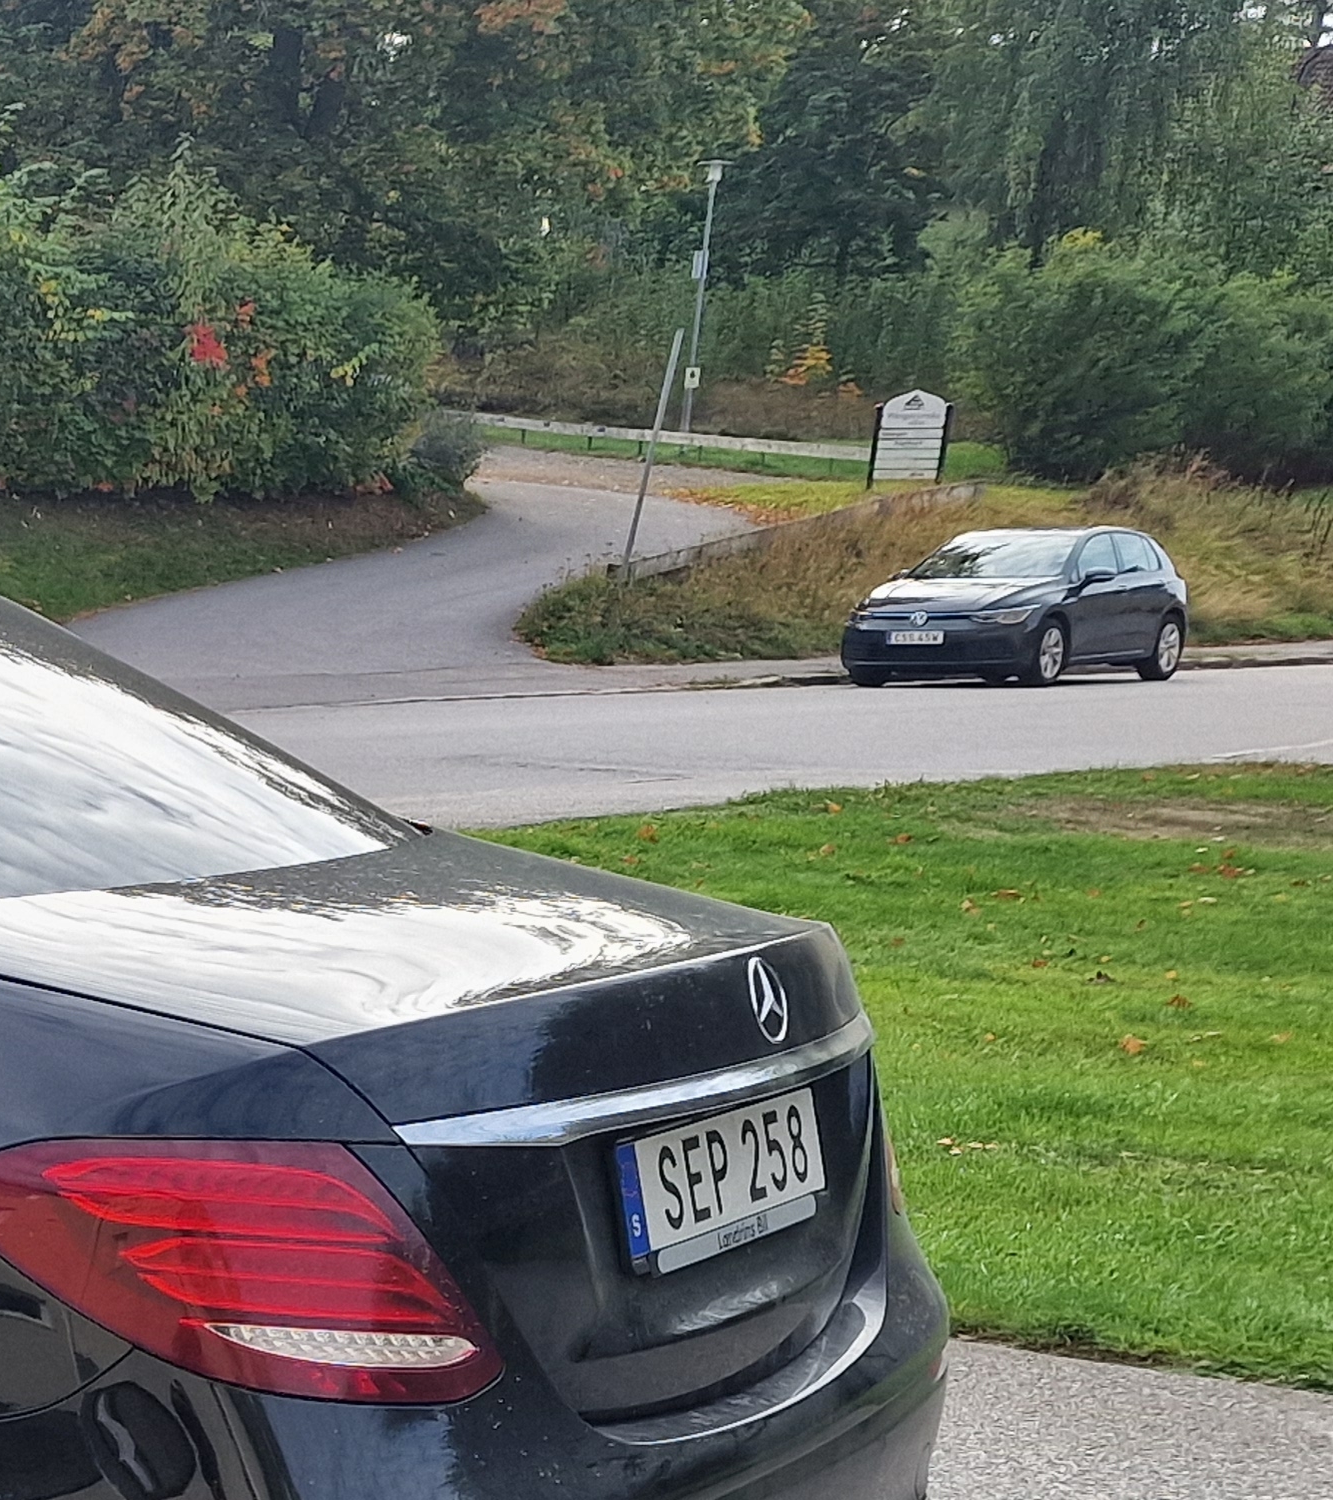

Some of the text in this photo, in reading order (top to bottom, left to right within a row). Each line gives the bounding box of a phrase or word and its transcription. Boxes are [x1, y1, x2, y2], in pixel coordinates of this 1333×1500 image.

[658, 1104, 808, 1230] SEP 258
[631, 1213, 642, 1238] S
